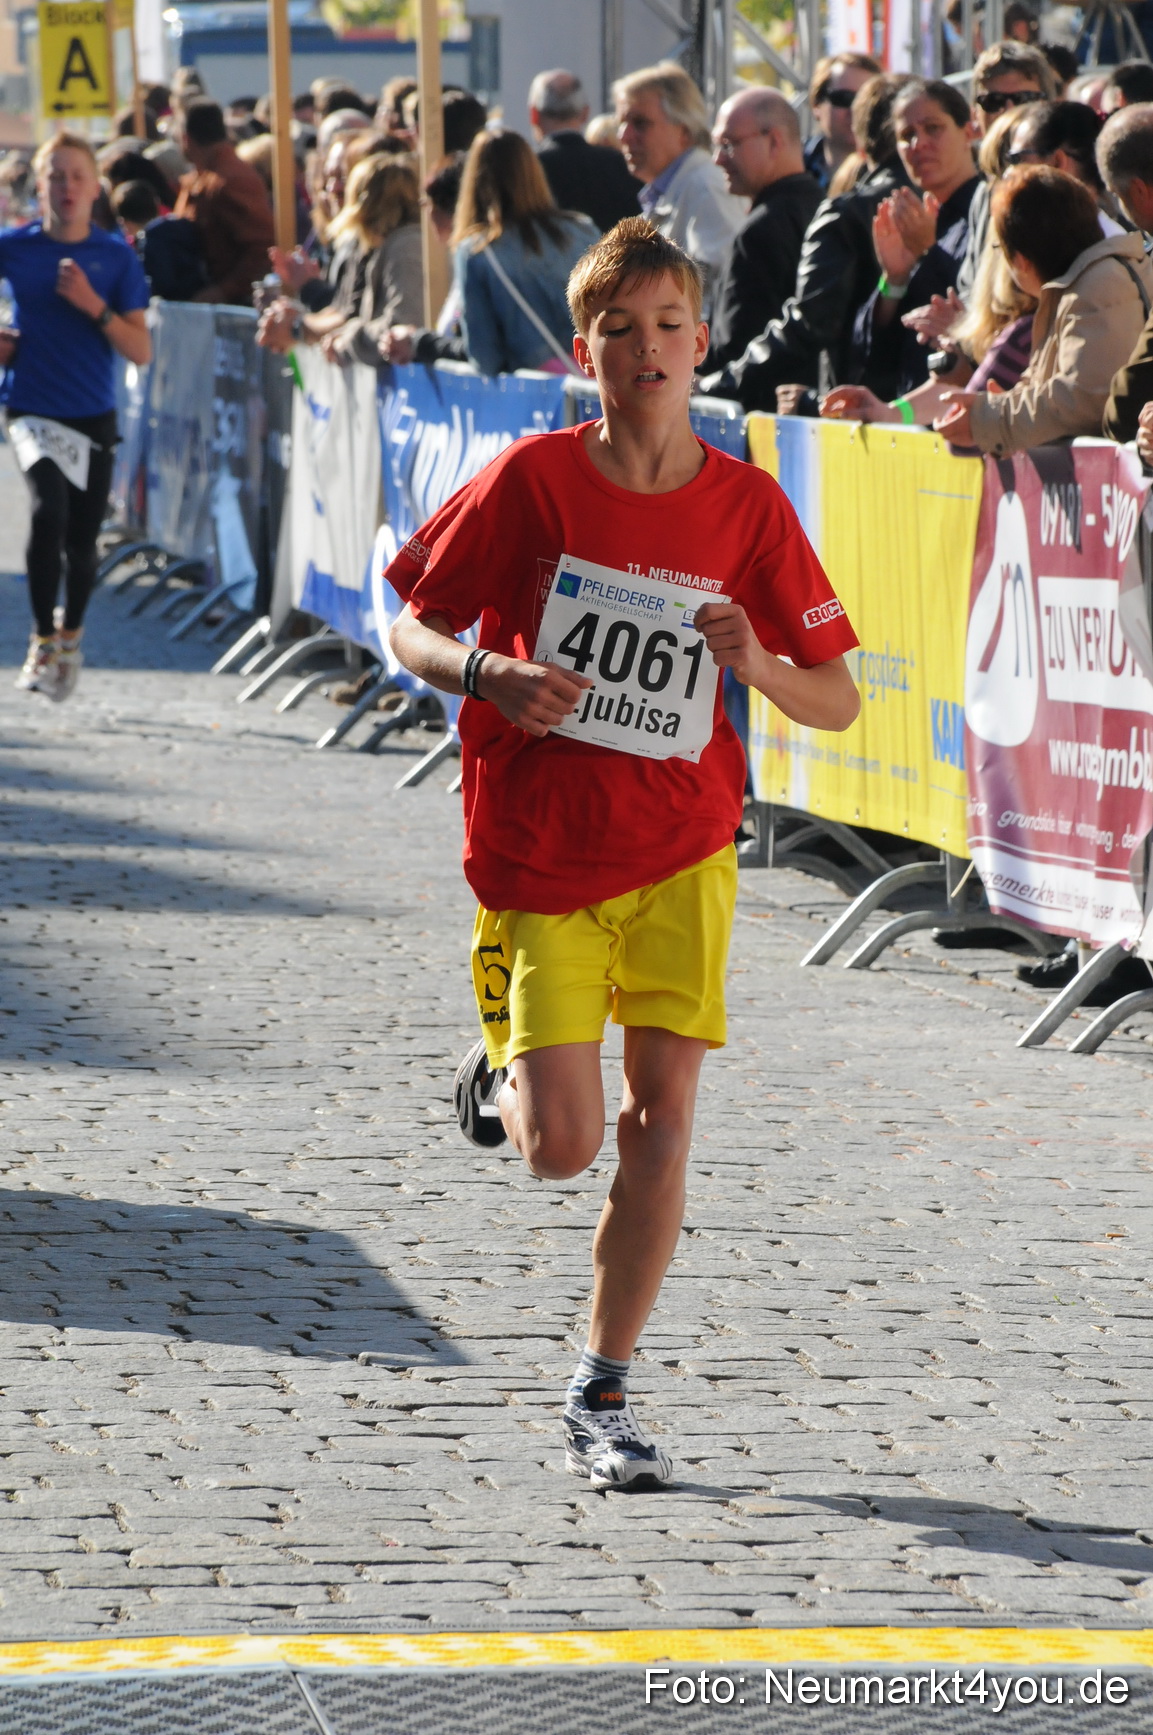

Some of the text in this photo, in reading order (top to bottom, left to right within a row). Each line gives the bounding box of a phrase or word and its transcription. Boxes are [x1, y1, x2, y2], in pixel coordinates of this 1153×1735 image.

[59, 37, 98, 91] A
[579, 594, 664, 623] AKTIENGESELLSCHAFT
[582, 578, 666, 613] PFLEIDERER
[557, 611, 705, 701] 4061
[1045, 604, 1066, 672] ZU
[572, 684, 682, 739] jubisa
[478, 942, 511, 1001] 5
[600, 1391, 623, 1402] PRO
